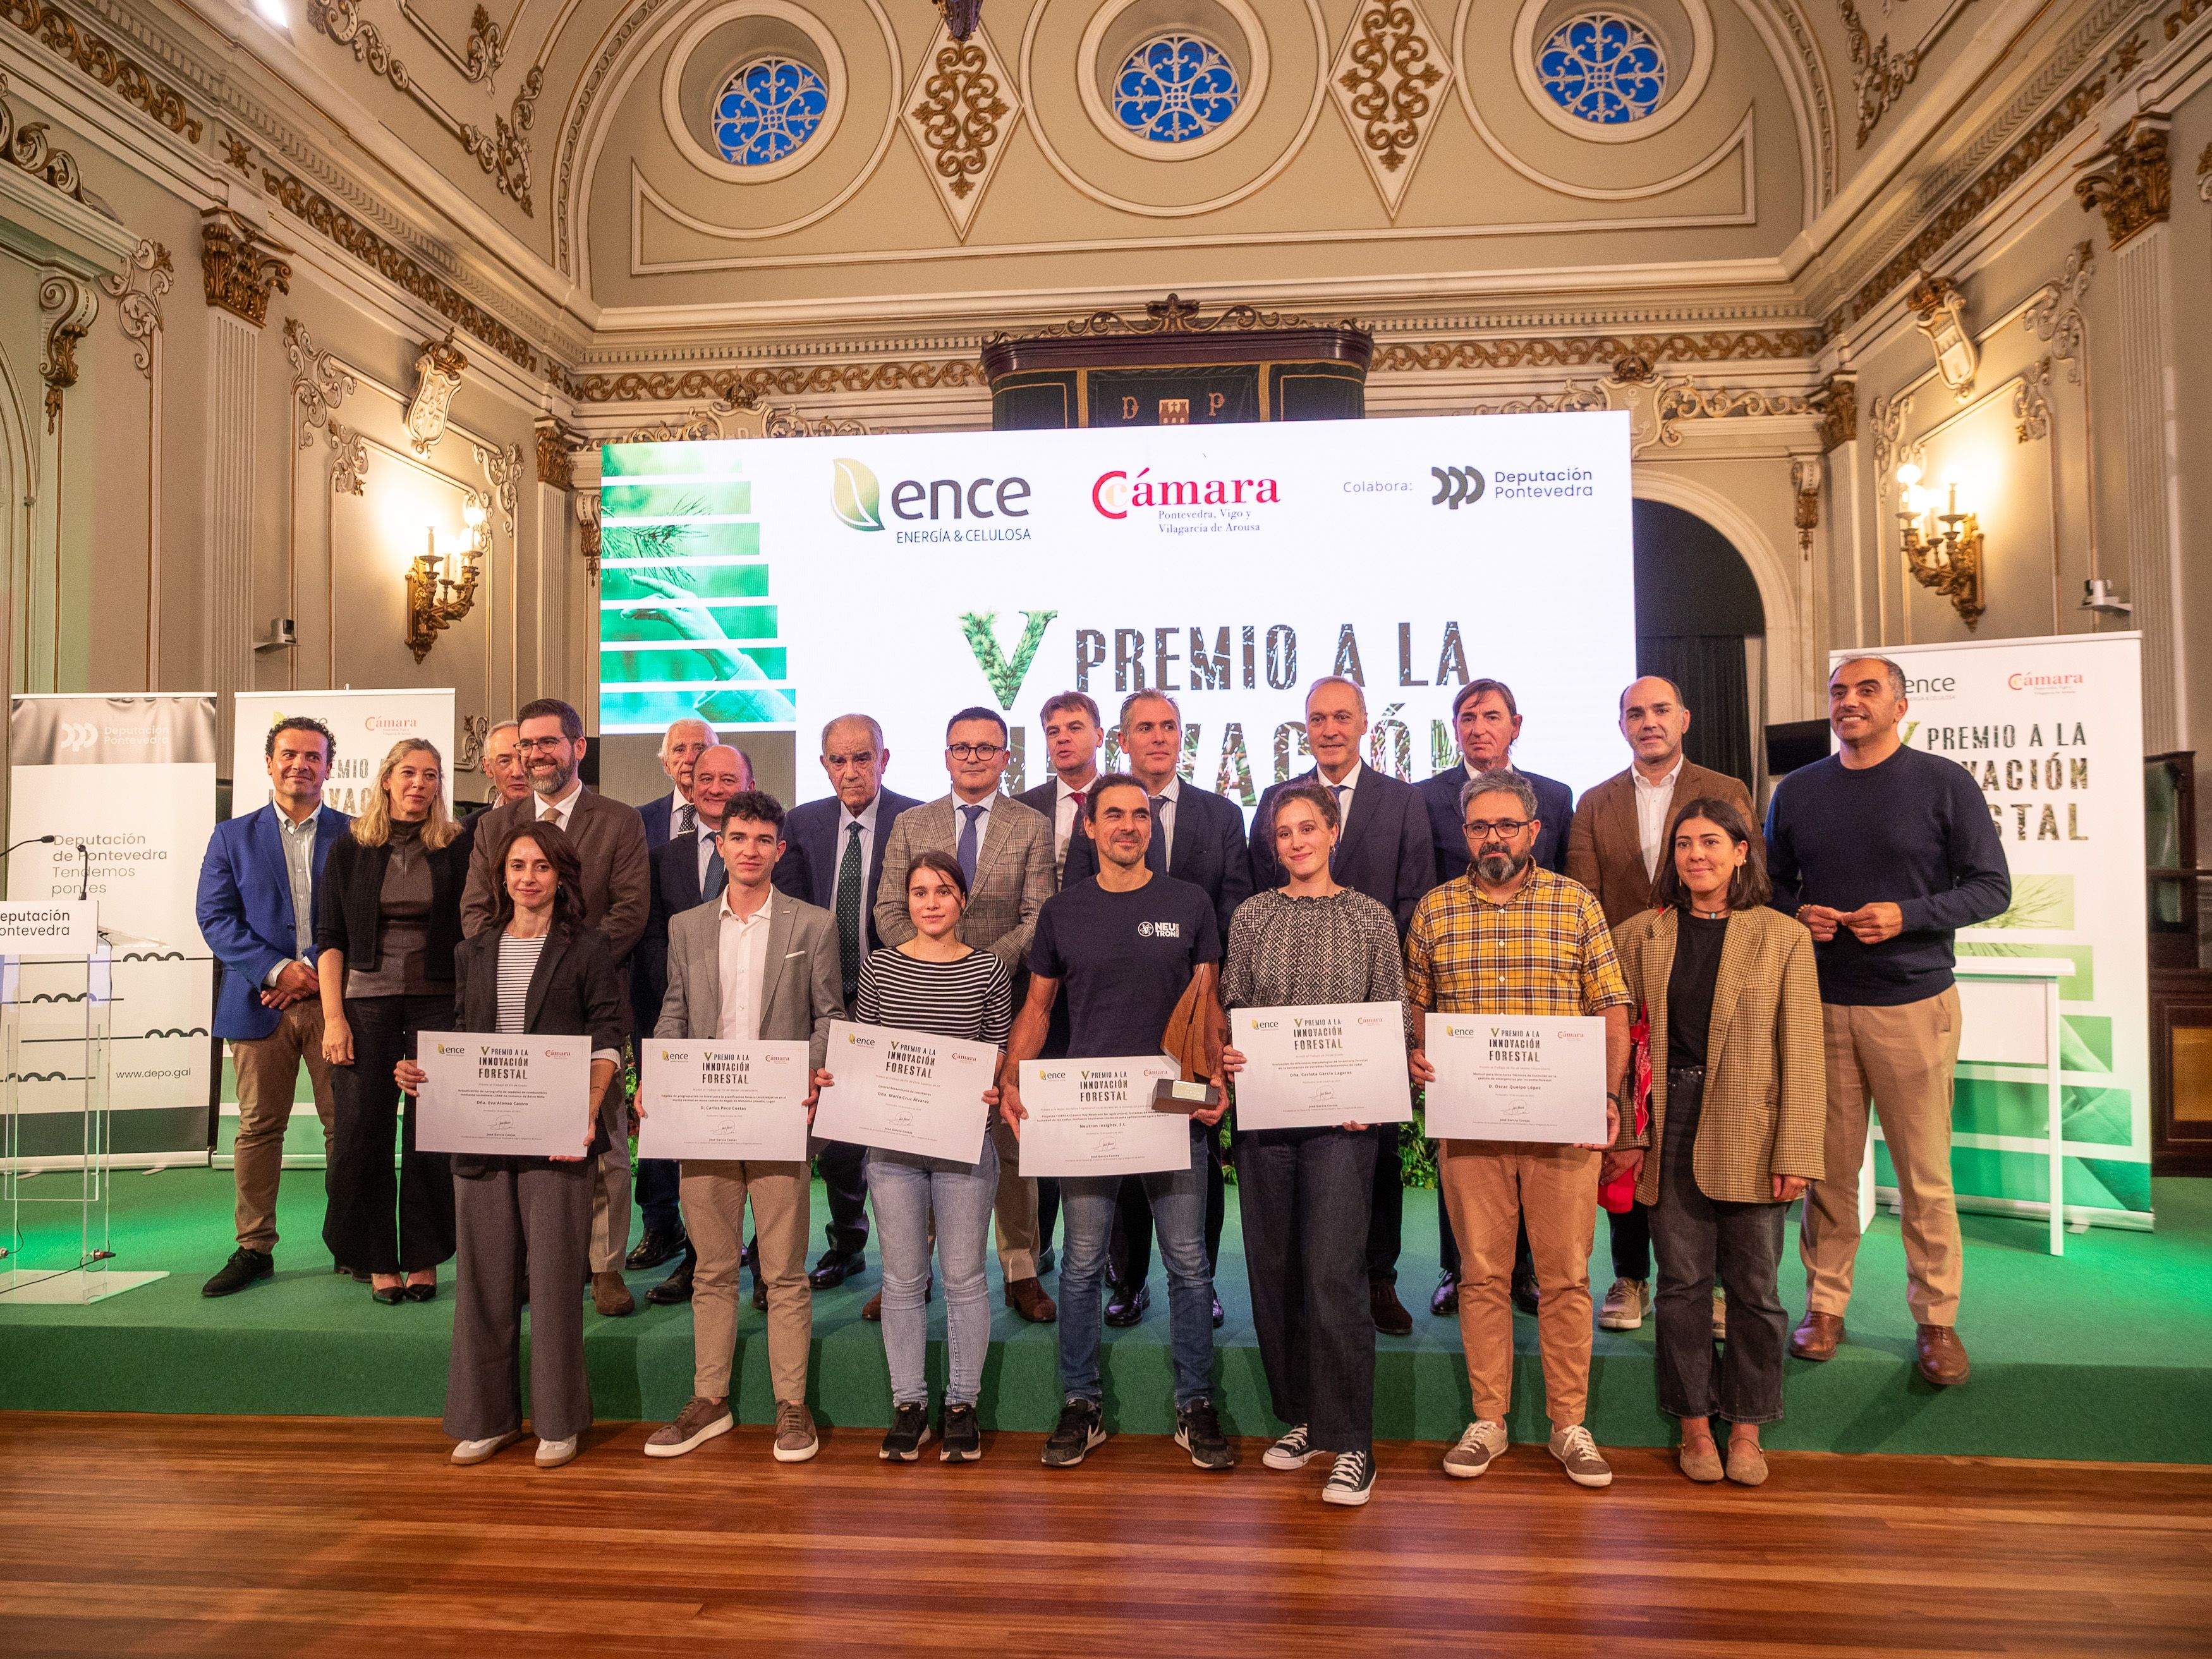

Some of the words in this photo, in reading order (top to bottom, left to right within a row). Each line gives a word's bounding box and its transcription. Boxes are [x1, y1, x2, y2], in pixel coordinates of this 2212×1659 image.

[1122, 396, 1139, 420] D
[1208, 392, 1225, 416] P
[1495, 468, 1593, 485] Deputación
[1343, 480, 1413, 493] Colabora:
[1495, 485, 1593, 499] Pontevedra
[891, 477, 1031, 520] ence
[1092, 467, 1280, 520] Cámara
[1158, 508, 1215, 520] Pontevedra,
[1220, 508, 1243, 520] Vigo
[1245, 511, 1251, 520] y
[1211, 522, 1222, 533] de
[1225, 522, 1260, 533] Arousa
[896, 528, 950, 544] ENERGÍA
[954, 530, 963, 541] &
[966, 528, 1031, 542] CELULOSA
[1076, 624, 1297, 694] PREMIO
[1333, 623, 1366, 687] A
[1398, 621, 1470, 686] LA
[1927, 724, 2015, 751] PREMIO
[2029, 724, 2043, 747] A
[2057, 722, 2086, 746] LA
[54, 833, 145, 848] Deputación
[53, 851, 73, 861] de
[78, 849, 167, 861] Pontevedra
[52, 866, 135, 878] Tendemos
[52, 884, 106, 897] pones
[1, 909, 70, 925] eputación
[0, 924, 70, 937] ontevedra
[1155, 922, 1176, 932] NEU
[1260, 1021, 1279, 1029] ence
[1294, 1018, 1303, 1028] V
[1294, 1026, 1342, 1038] INNOVACIÓN
[1490, 1028, 1500, 1037] V
[856, 1036, 875, 1046] ence
[1294, 1038, 1344, 1050] FORESTAL
[1490, 1038, 1540, 1049] INNOVACIÓN
[446, 1046, 465, 1054] ence
[481, 1046, 490, 1055] V
[890, 1040, 900, 1050] V
[901, 1044, 921, 1054] PREMIO
[928, 1048, 936, 1056] LA
[479, 1056, 528, 1067] INNOVACIÓN
[704, 1052, 712, 1061] V
[887, 1050, 935, 1066] INNOVACIÓN
[1489, 1050, 1540, 1062] FORESTAL
[702, 1061, 750, 1071] INNOVACIÓN
[885, 1062, 933, 1079] FORESTAL
[116, 1067, 191, 1079] www.depo.gal
[478, 1068, 528, 1079] FORESTAL
[702, 1073, 749, 1085] FORESTAL
[1081, 1071, 1090, 1080] V
[1080, 1079, 1128, 1090] INNOVACIÓN
[1080, 1090, 1128, 1102] FORESTAL
